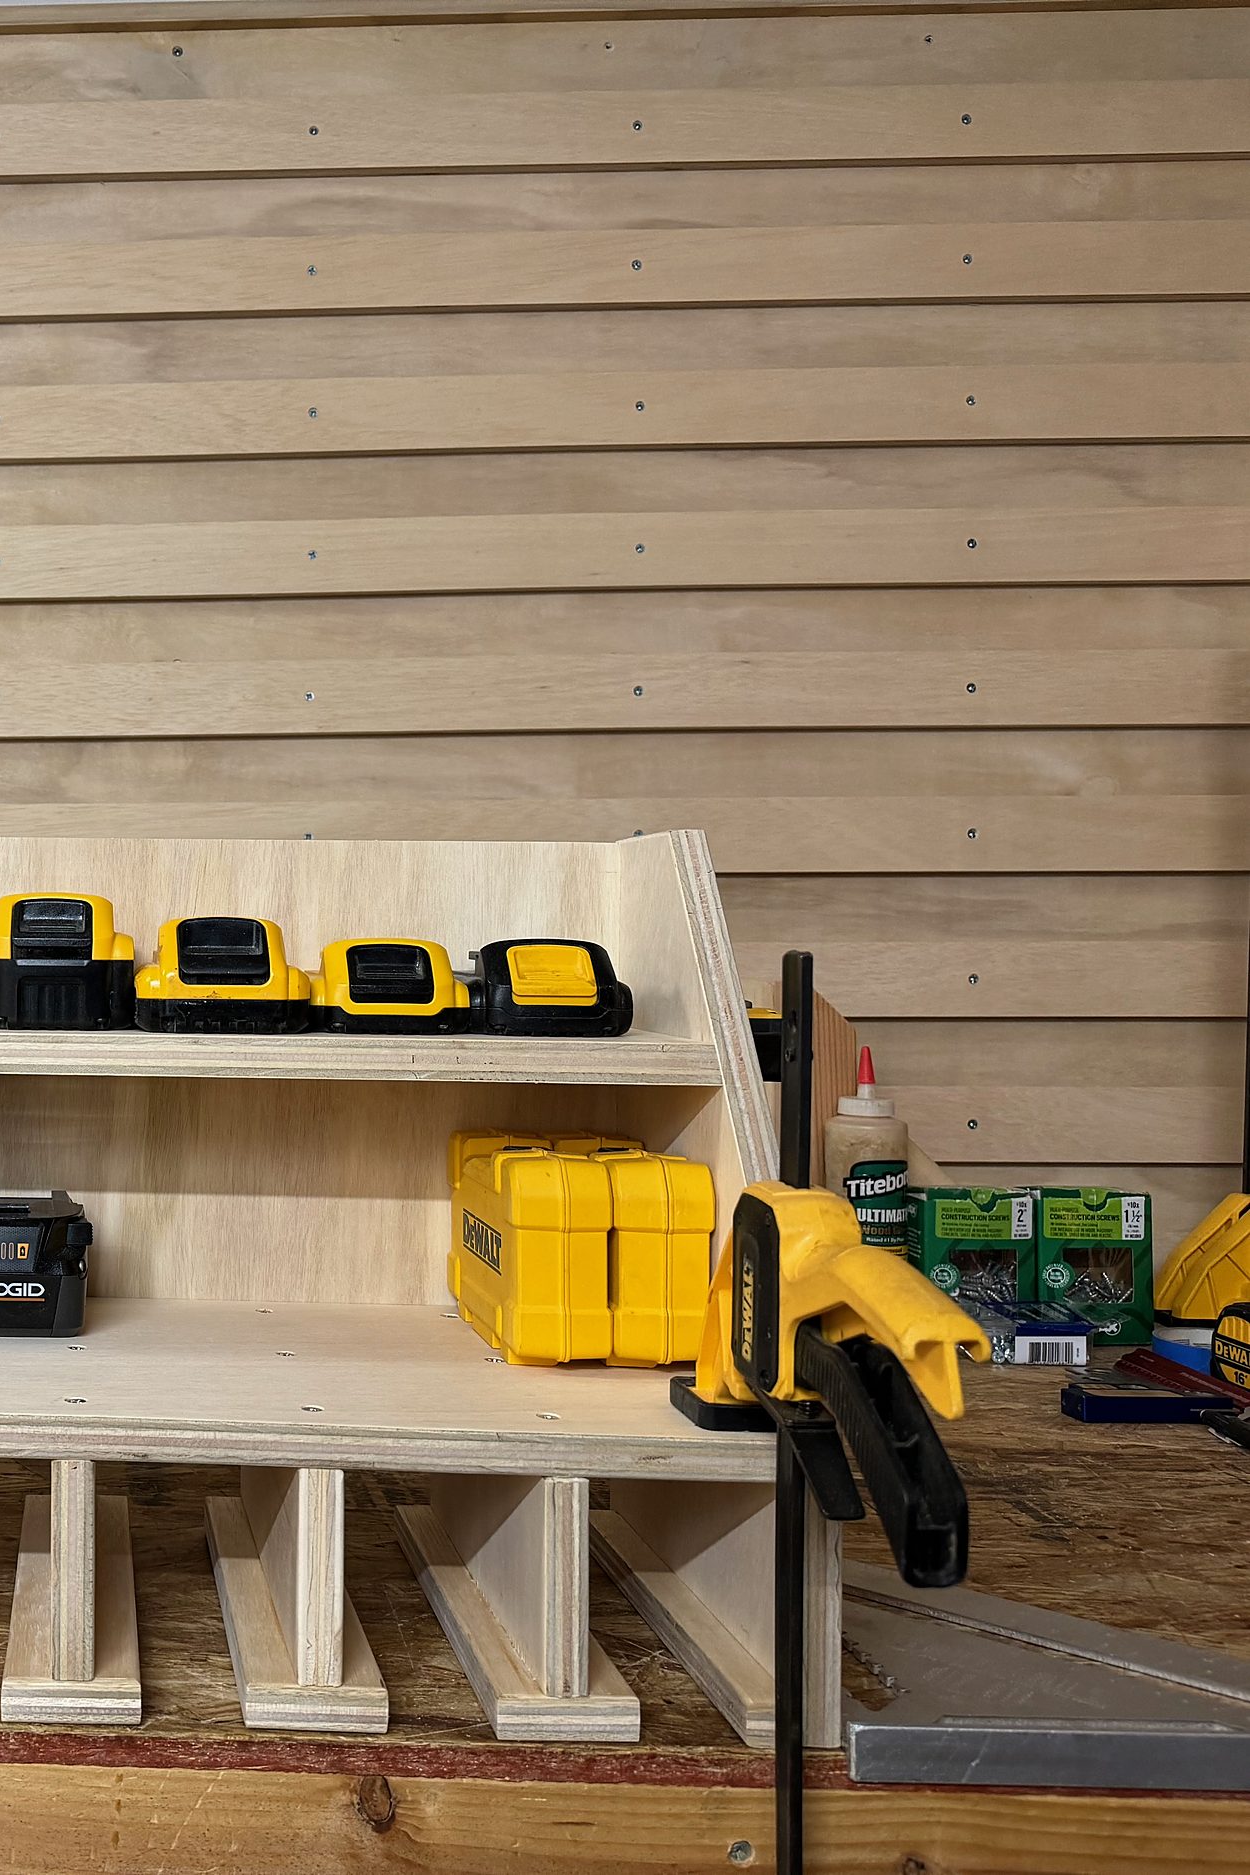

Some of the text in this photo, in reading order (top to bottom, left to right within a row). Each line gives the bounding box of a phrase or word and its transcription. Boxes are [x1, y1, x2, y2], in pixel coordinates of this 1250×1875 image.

[941, 1213, 1010, 1222] CONSTRUCTION SCREWS
[1049, 1213, 1120, 1222] CONSTRUCTION SCREWS
[462, 1212, 502, 1269] DEWALT
[1215, 1340, 1250, 1366] DEWA
